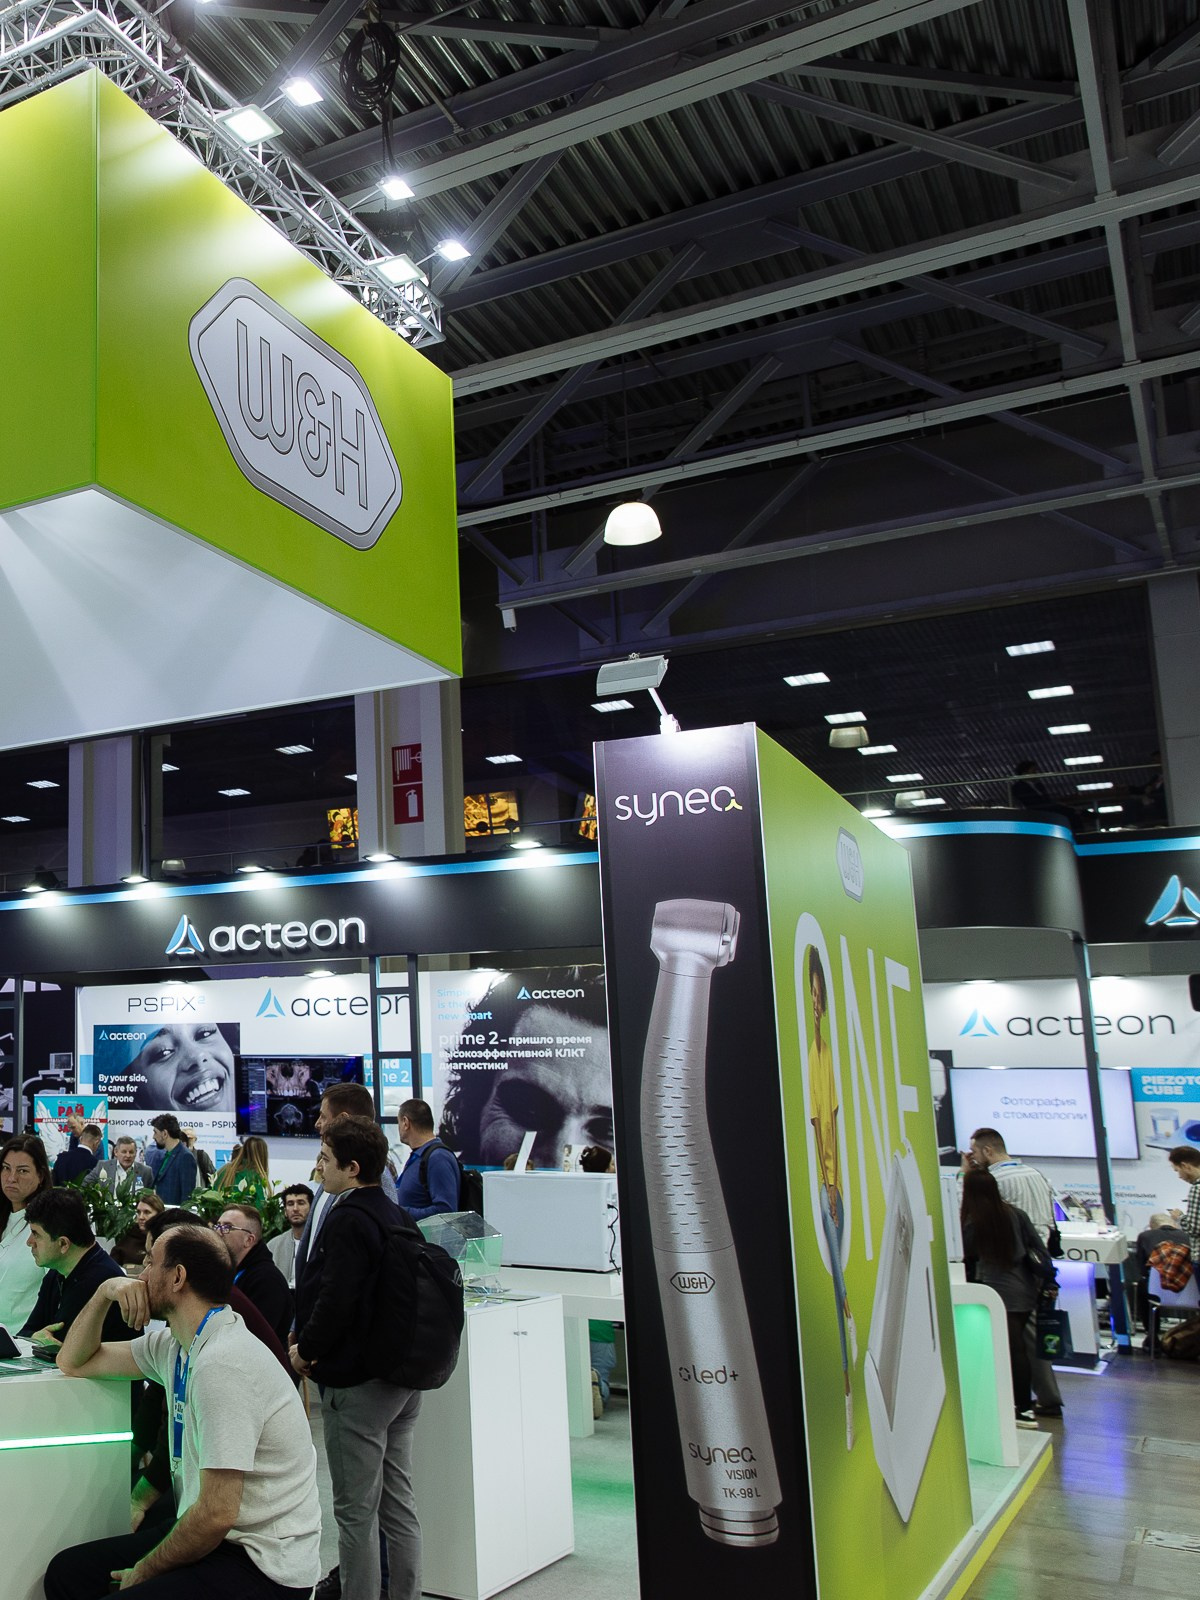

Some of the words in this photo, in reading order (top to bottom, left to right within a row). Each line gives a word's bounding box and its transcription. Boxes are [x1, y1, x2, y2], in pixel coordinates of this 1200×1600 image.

[236, 319, 369, 512] W&H
[614, 784, 743, 826] synea
[208, 916, 366, 952] acteon
[531, 987, 585, 1000] acteon
[1007, 1013, 1175, 1037] acteon
[109, 1031, 147, 1041] acteon
[439, 1033, 486, 1048] prime
[488, 1031, 499, 1045] 2
[509, 1036, 554, 1048] пришло
[556, 1035, 592, 1047] время
[555, 1048, 585, 1058] КЛКТ
[439, 1061, 508, 1072] диагностики
[98, 1073, 109, 1083] By
[110, 1074, 128, 1083] your
[129, 1073, 148, 1083] side,
[400, 1070, 410, 1083] 2
[98, 1084, 107, 1092] to
[127, 1083, 138, 1092] for
[1142, 1085, 1184, 1095] CUBE
[107, 1094, 134, 1103] eryone
[1000, 1096, 1077, 1107] Фотография
[1003, 1112, 1087, 1120] стоматологии
[108, 1119, 145, 1128] изиограф
[677, 1276, 709, 1289] W&H
[688, 1442, 757, 1466] synea
[725, 1468, 758, 1480] VISION
